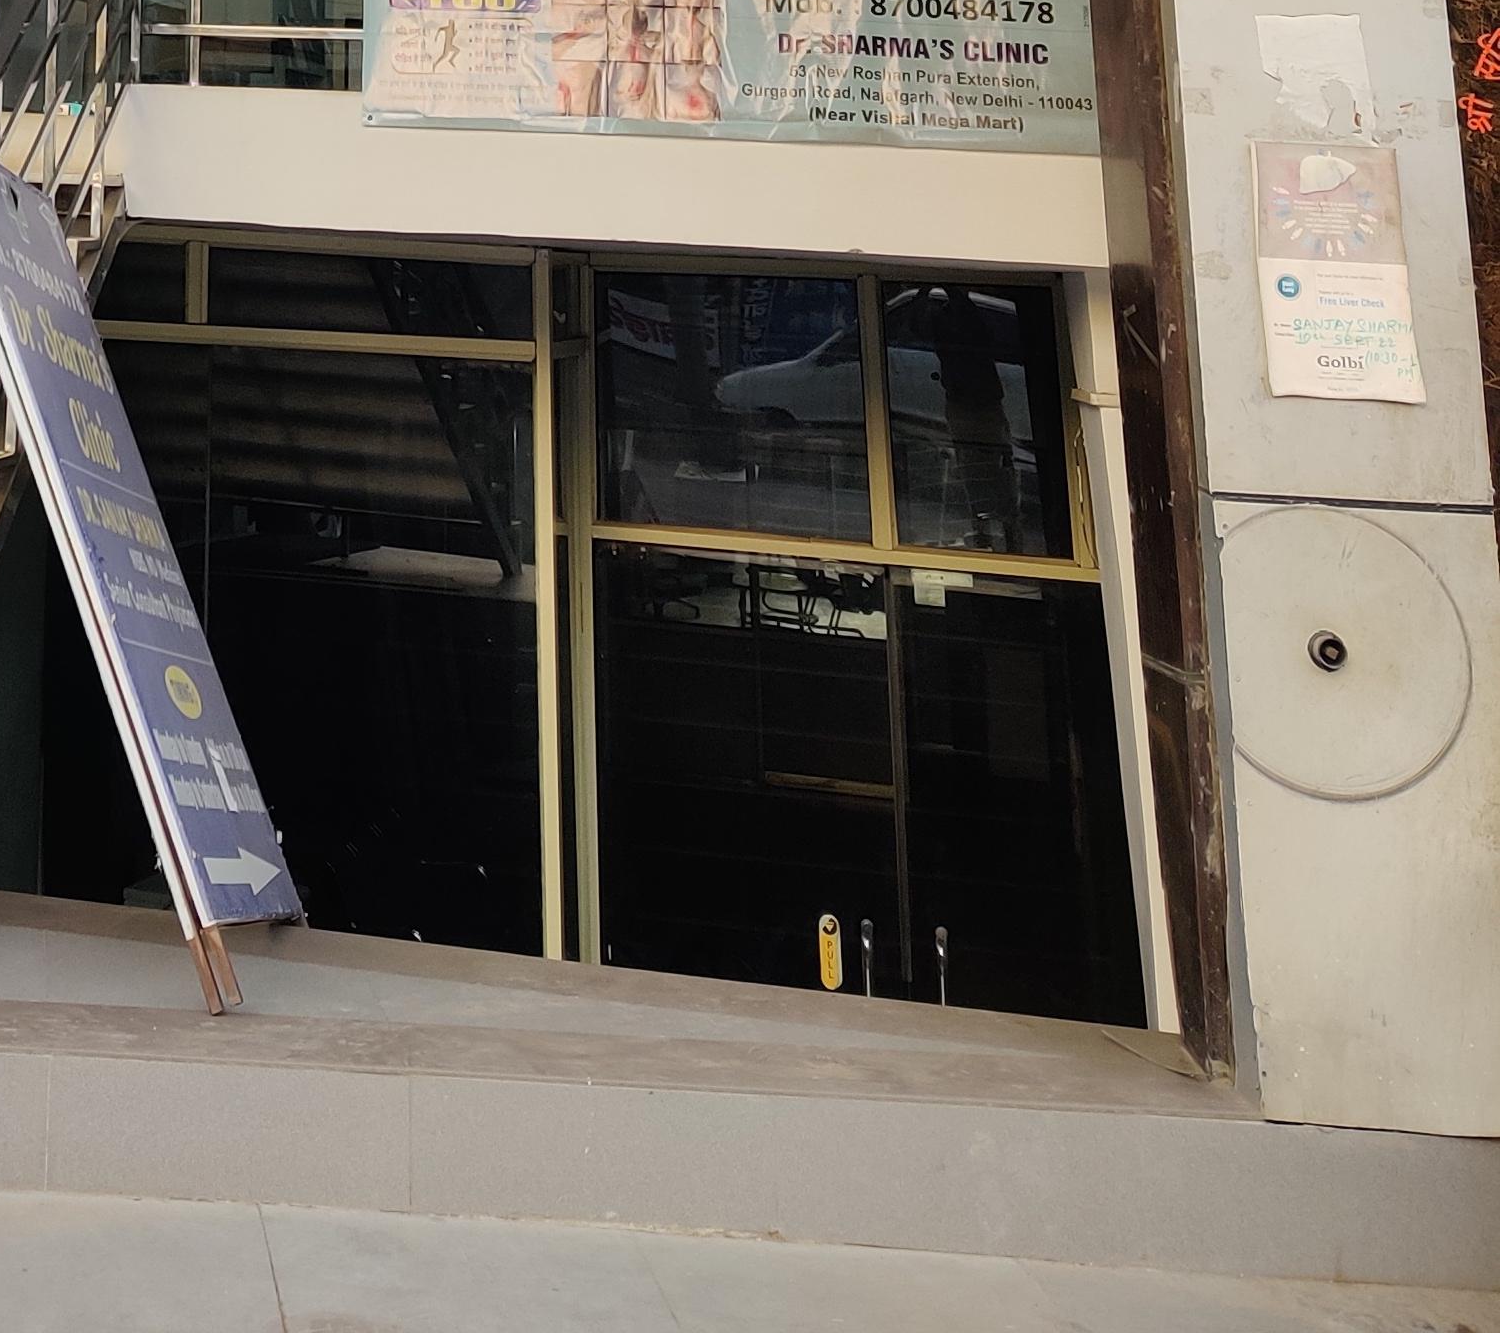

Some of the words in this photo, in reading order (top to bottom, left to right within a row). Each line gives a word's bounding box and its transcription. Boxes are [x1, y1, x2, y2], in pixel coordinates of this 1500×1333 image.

[778, 33, 812, 55] Dr.
[821, 34, 955, 60] SHARMA'S
[964, 40, 1049, 65] CLINIC
[826, 939, 835, 980] PULL
